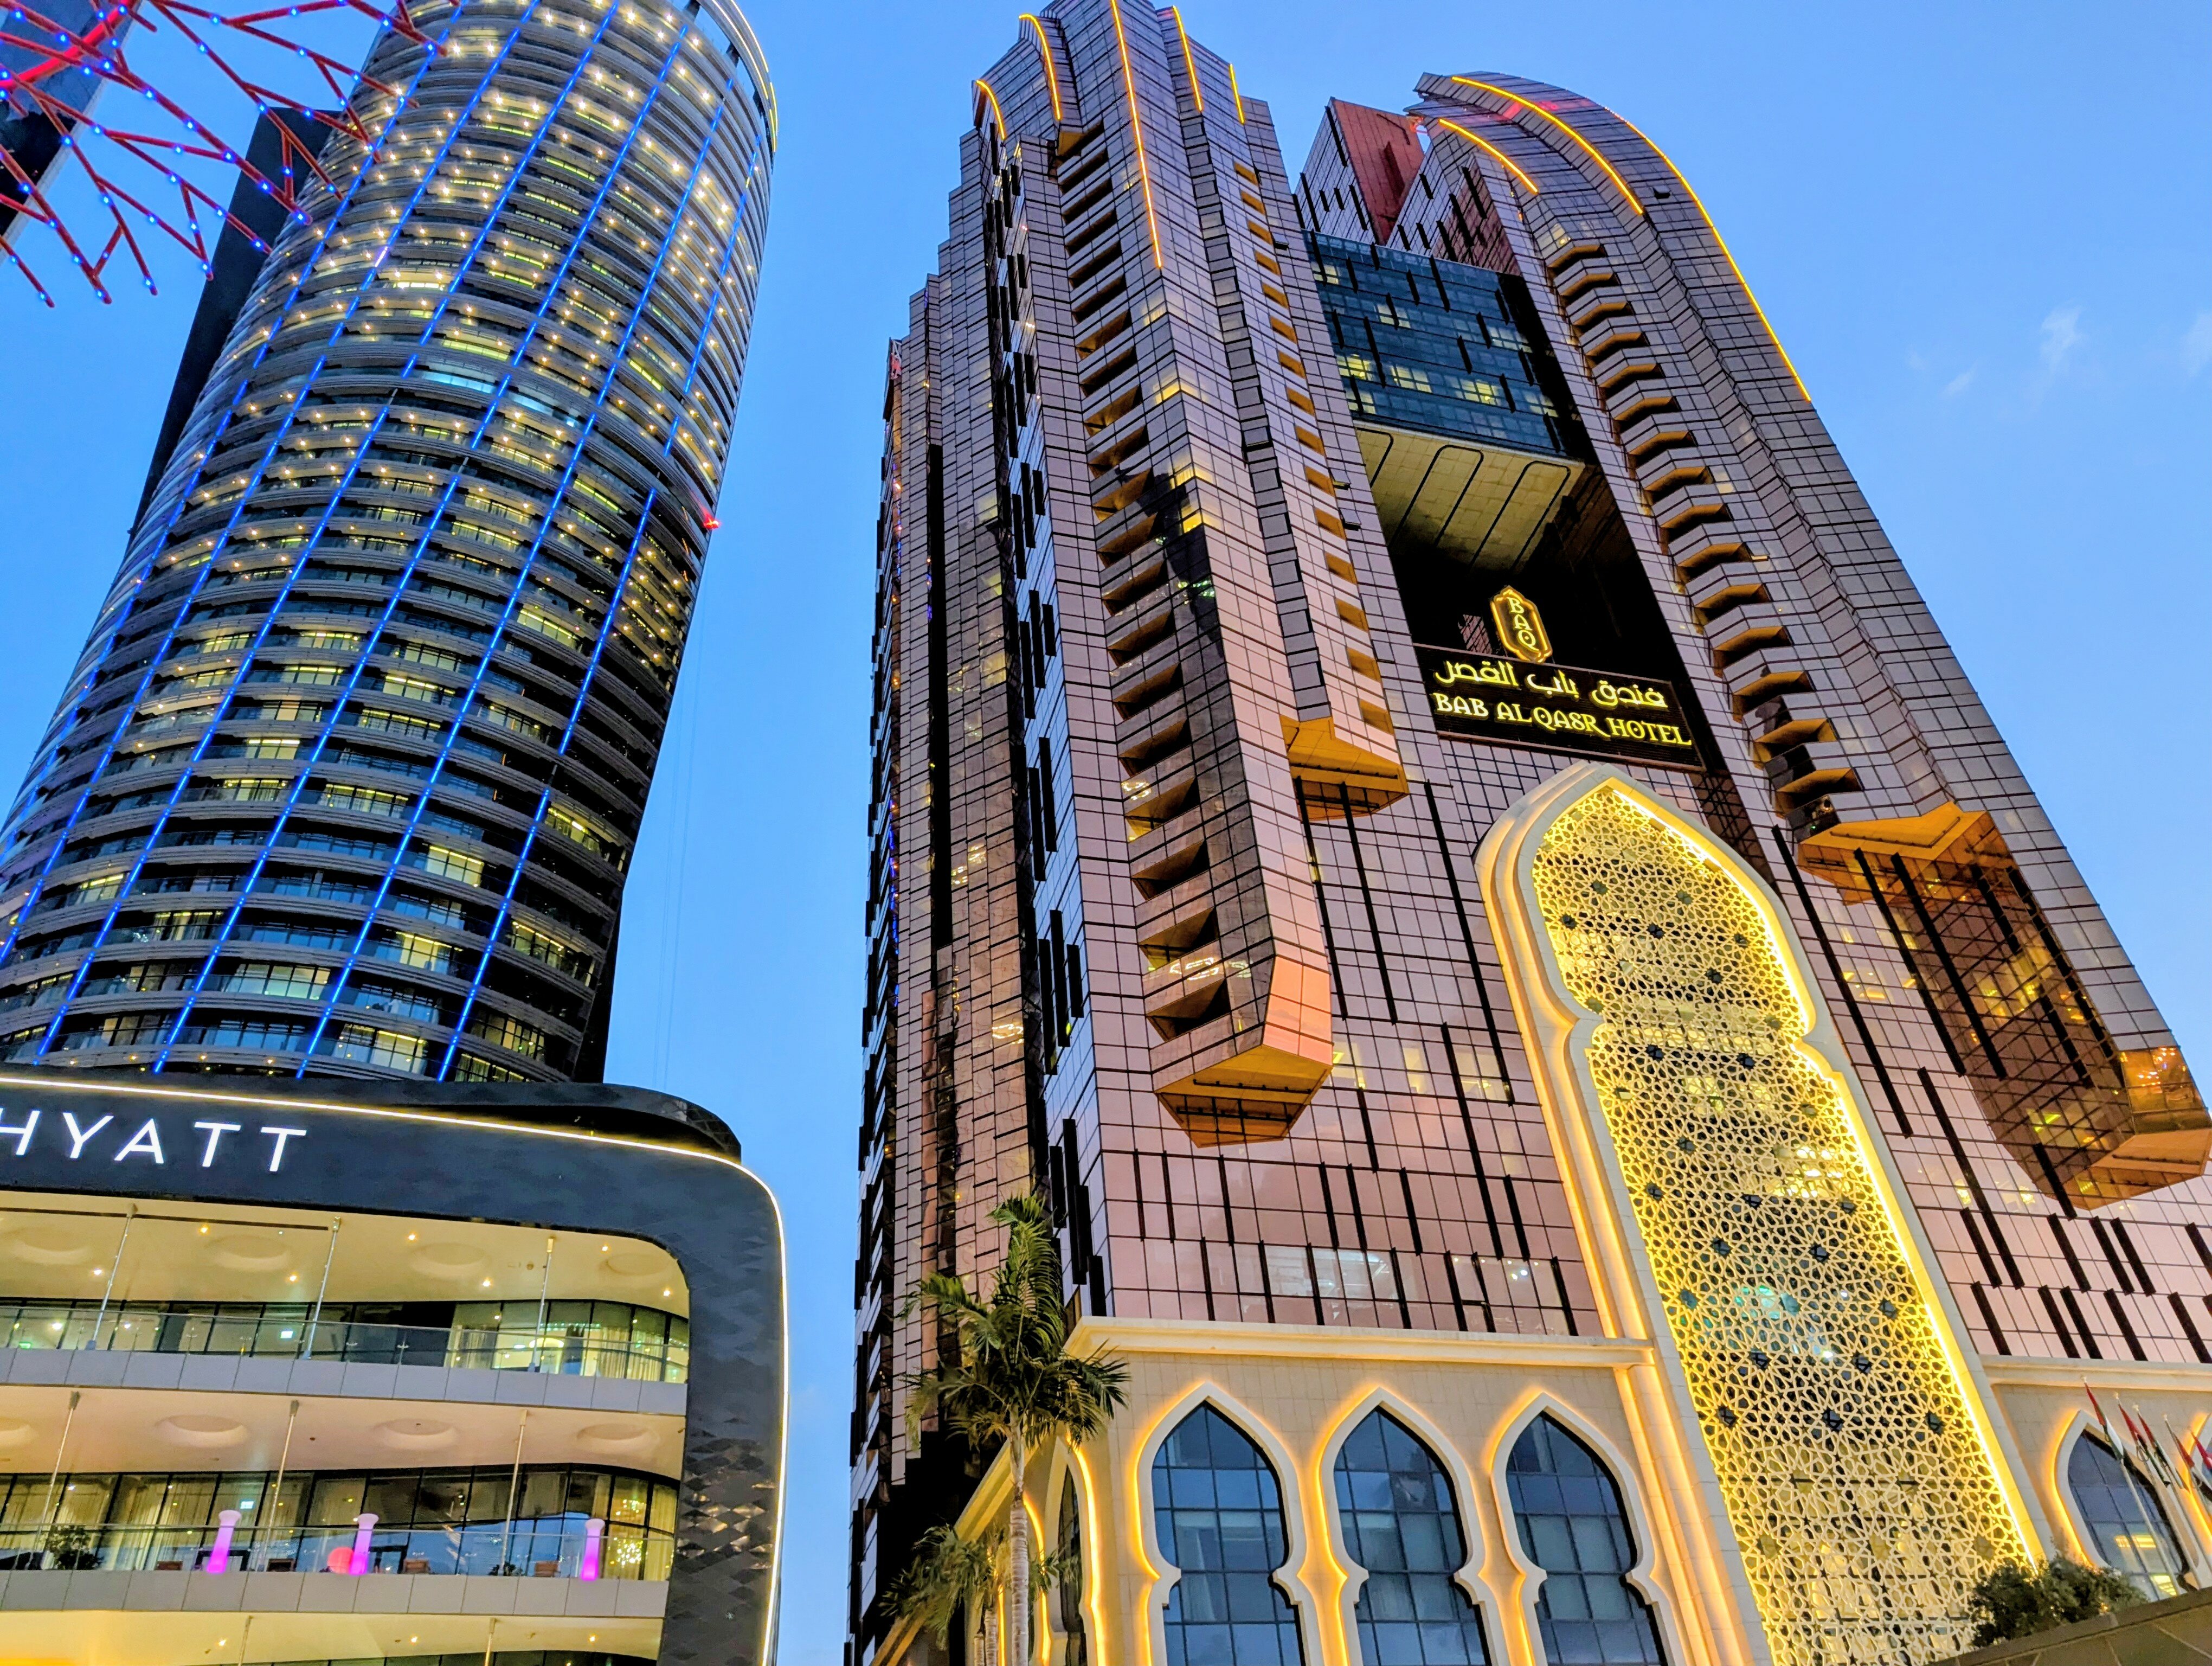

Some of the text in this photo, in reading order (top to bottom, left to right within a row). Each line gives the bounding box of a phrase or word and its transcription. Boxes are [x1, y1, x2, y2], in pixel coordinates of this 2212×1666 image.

[1506, 597, 1540, 651] BAQ
[1435, 661, 1668, 708] فندق باب القصر
[1432, 692, 1692, 746] BAB AL QASR HOTEL
[0, 1107, 307, 1172] HYATT
